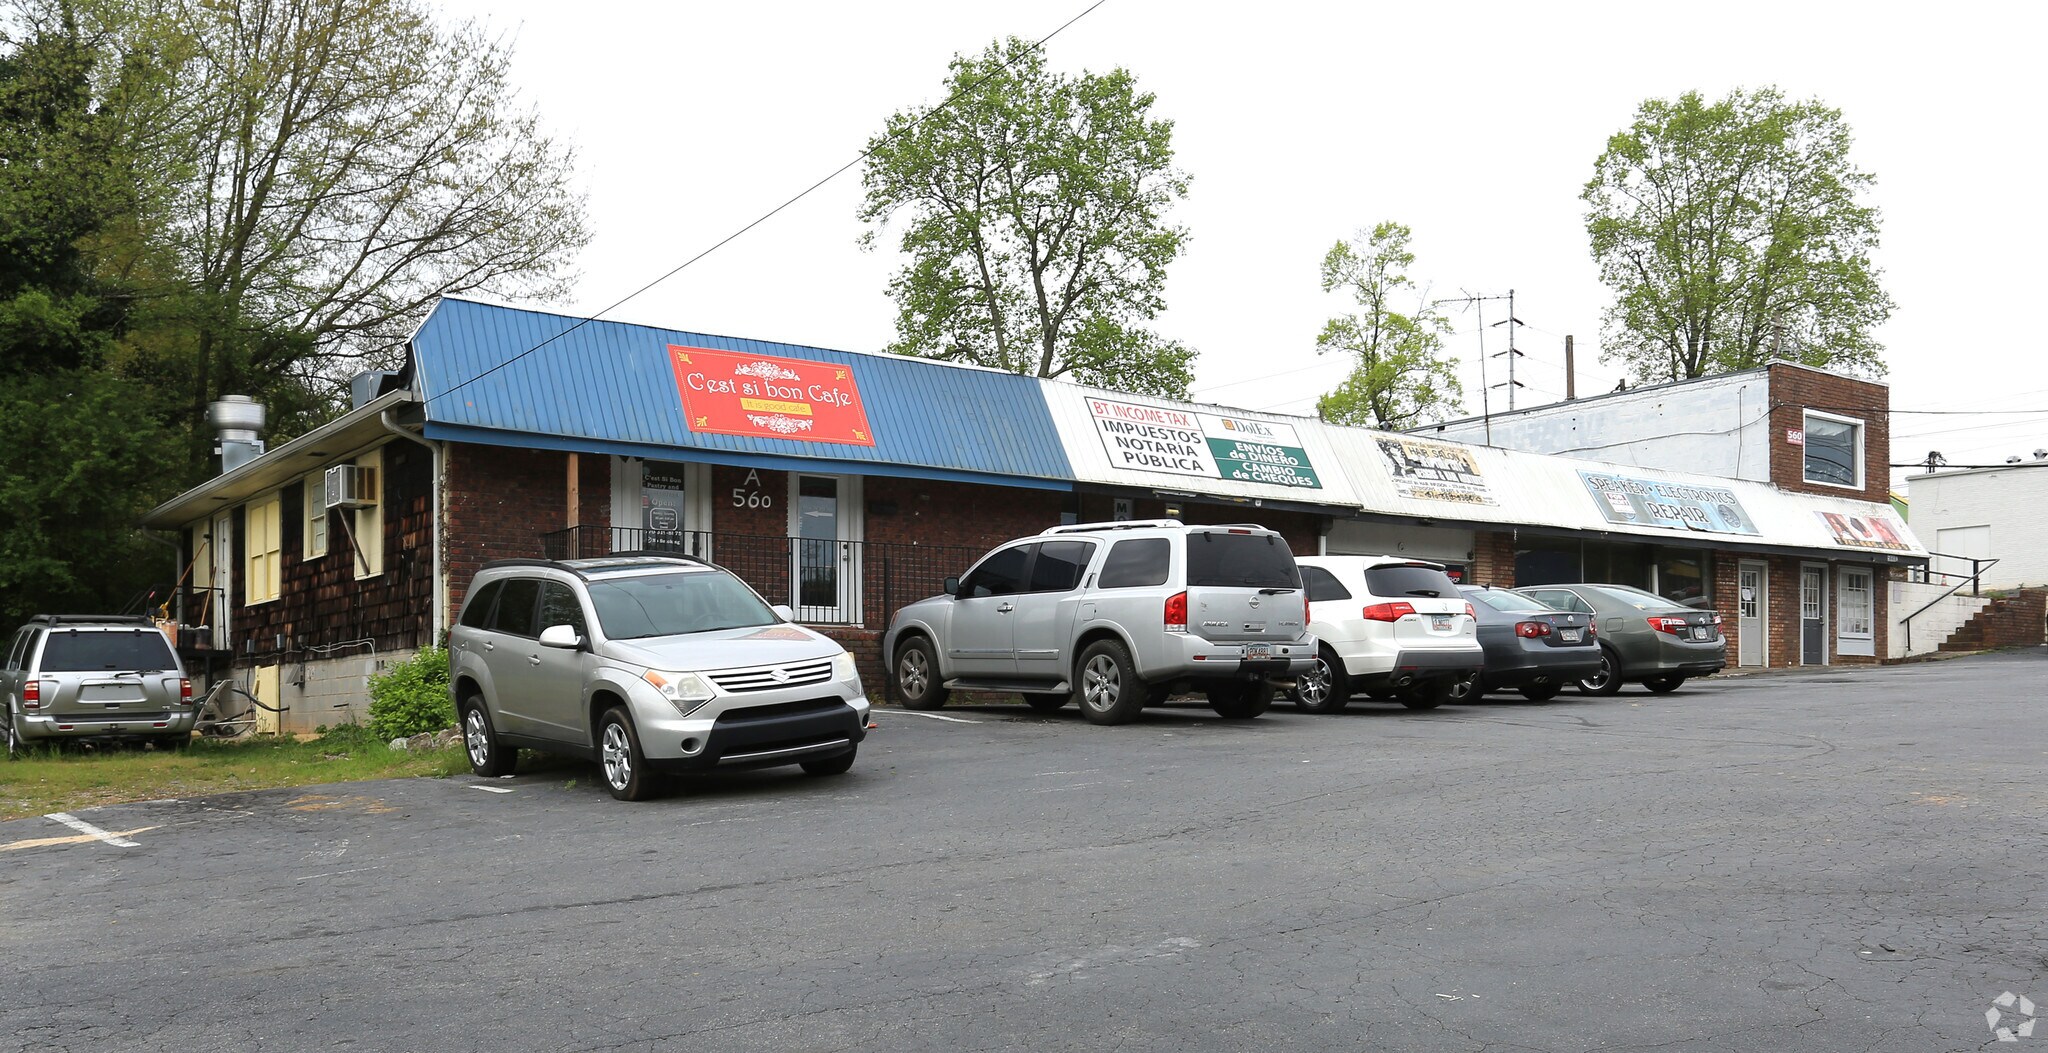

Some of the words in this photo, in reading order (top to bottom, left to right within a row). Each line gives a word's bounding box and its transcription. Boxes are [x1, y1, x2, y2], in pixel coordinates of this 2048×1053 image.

[742, 379, 759, 396] si
[764, 379, 804, 400] bon
[808, 384, 852, 408] Cafe
[764, 403, 787, 411] good
[1093, 401, 1111, 415] BT
[1111, 404, 1165, 424] INCOME
[1166, 411, 1191, 427] TAX
[1102, 419, 1202, 445] IMPUESTOS
[1233, 420, 1274, 437] DolEx
[1787, 430, 1803, 440] 560
[1115, 435, 1198, 457] NOTARÍA
[1235, 442, 1285, 456] ENVÍOS
[1408, 446, 1430, 458] HAIR
[1431, 449, 1462, 463] SALON
[1124, 451, 1205, 472] PÚBLICA
[1229, 449, 1247, 460] de
[1248, 451, 1299, 467] DINERO
[744, 468, 761, 487] A
[1232, 469, 1250, 480] de
[1251, 470, 1314, 487] CHEQUES
[1242, 462, 1296, 477] CAMBIO
[732, 488, 772, 509] 560
[1587, 476, 1650, 496] SPEAKER
[1654, 483, 1737, 505] ELECTRONICS
[1647, 502, 1710, 524] REPAIR
